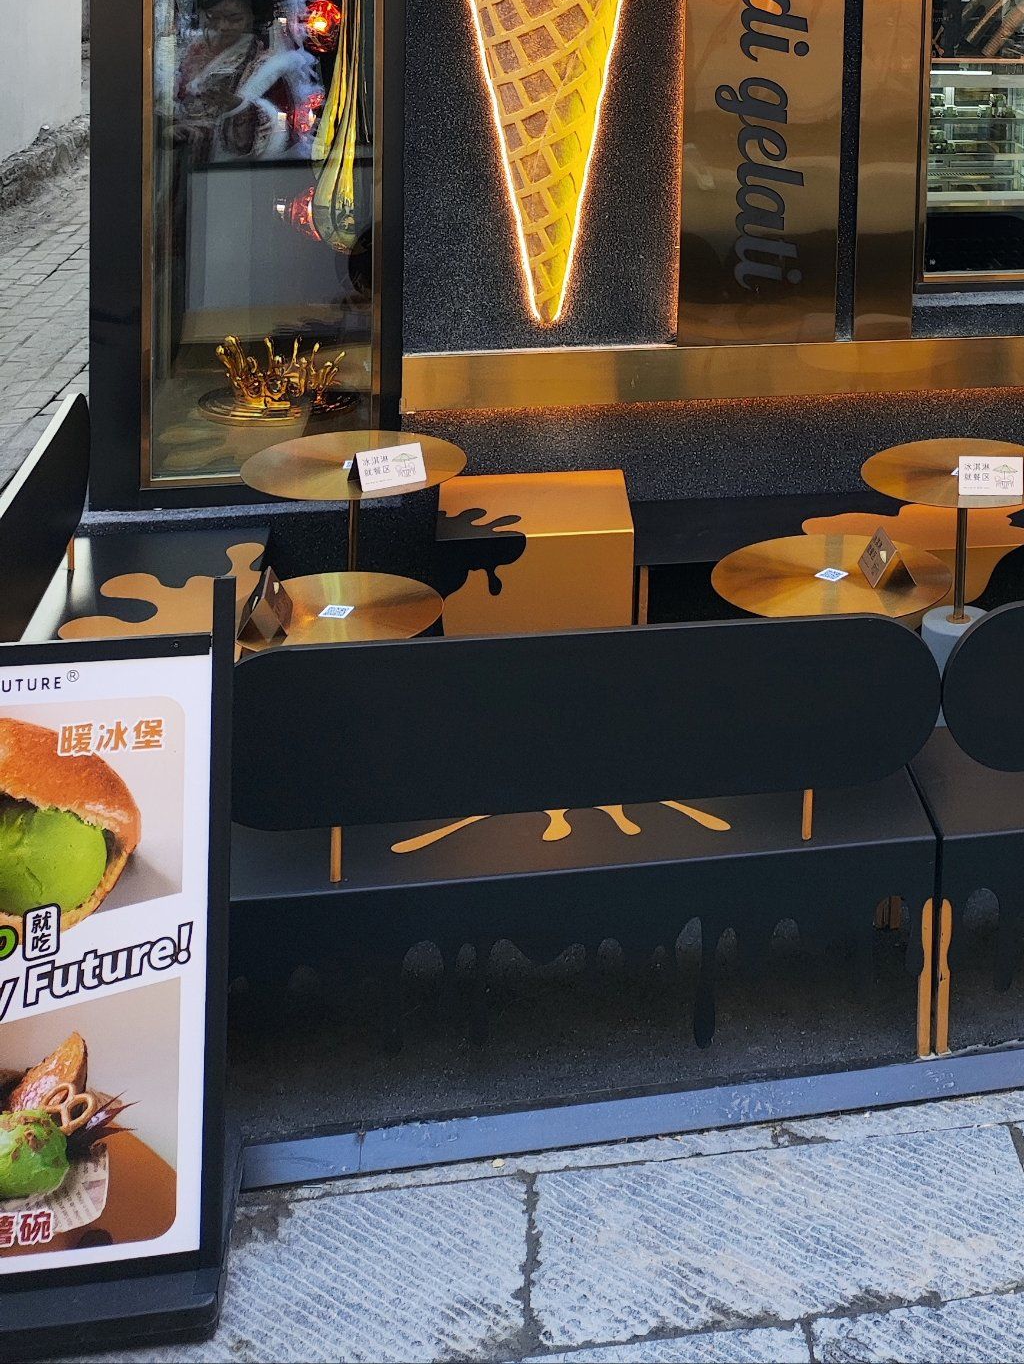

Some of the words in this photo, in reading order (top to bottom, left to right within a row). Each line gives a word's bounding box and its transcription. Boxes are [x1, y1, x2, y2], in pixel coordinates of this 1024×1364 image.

[714, 76, 805, 292] gelati
[1, 677, 62, 693] UTURE
[58, 718, 165, 756] 暖冰堡
[30, 910, 52, 954] 就吃
[22, 921, 194, 1009] Future!
